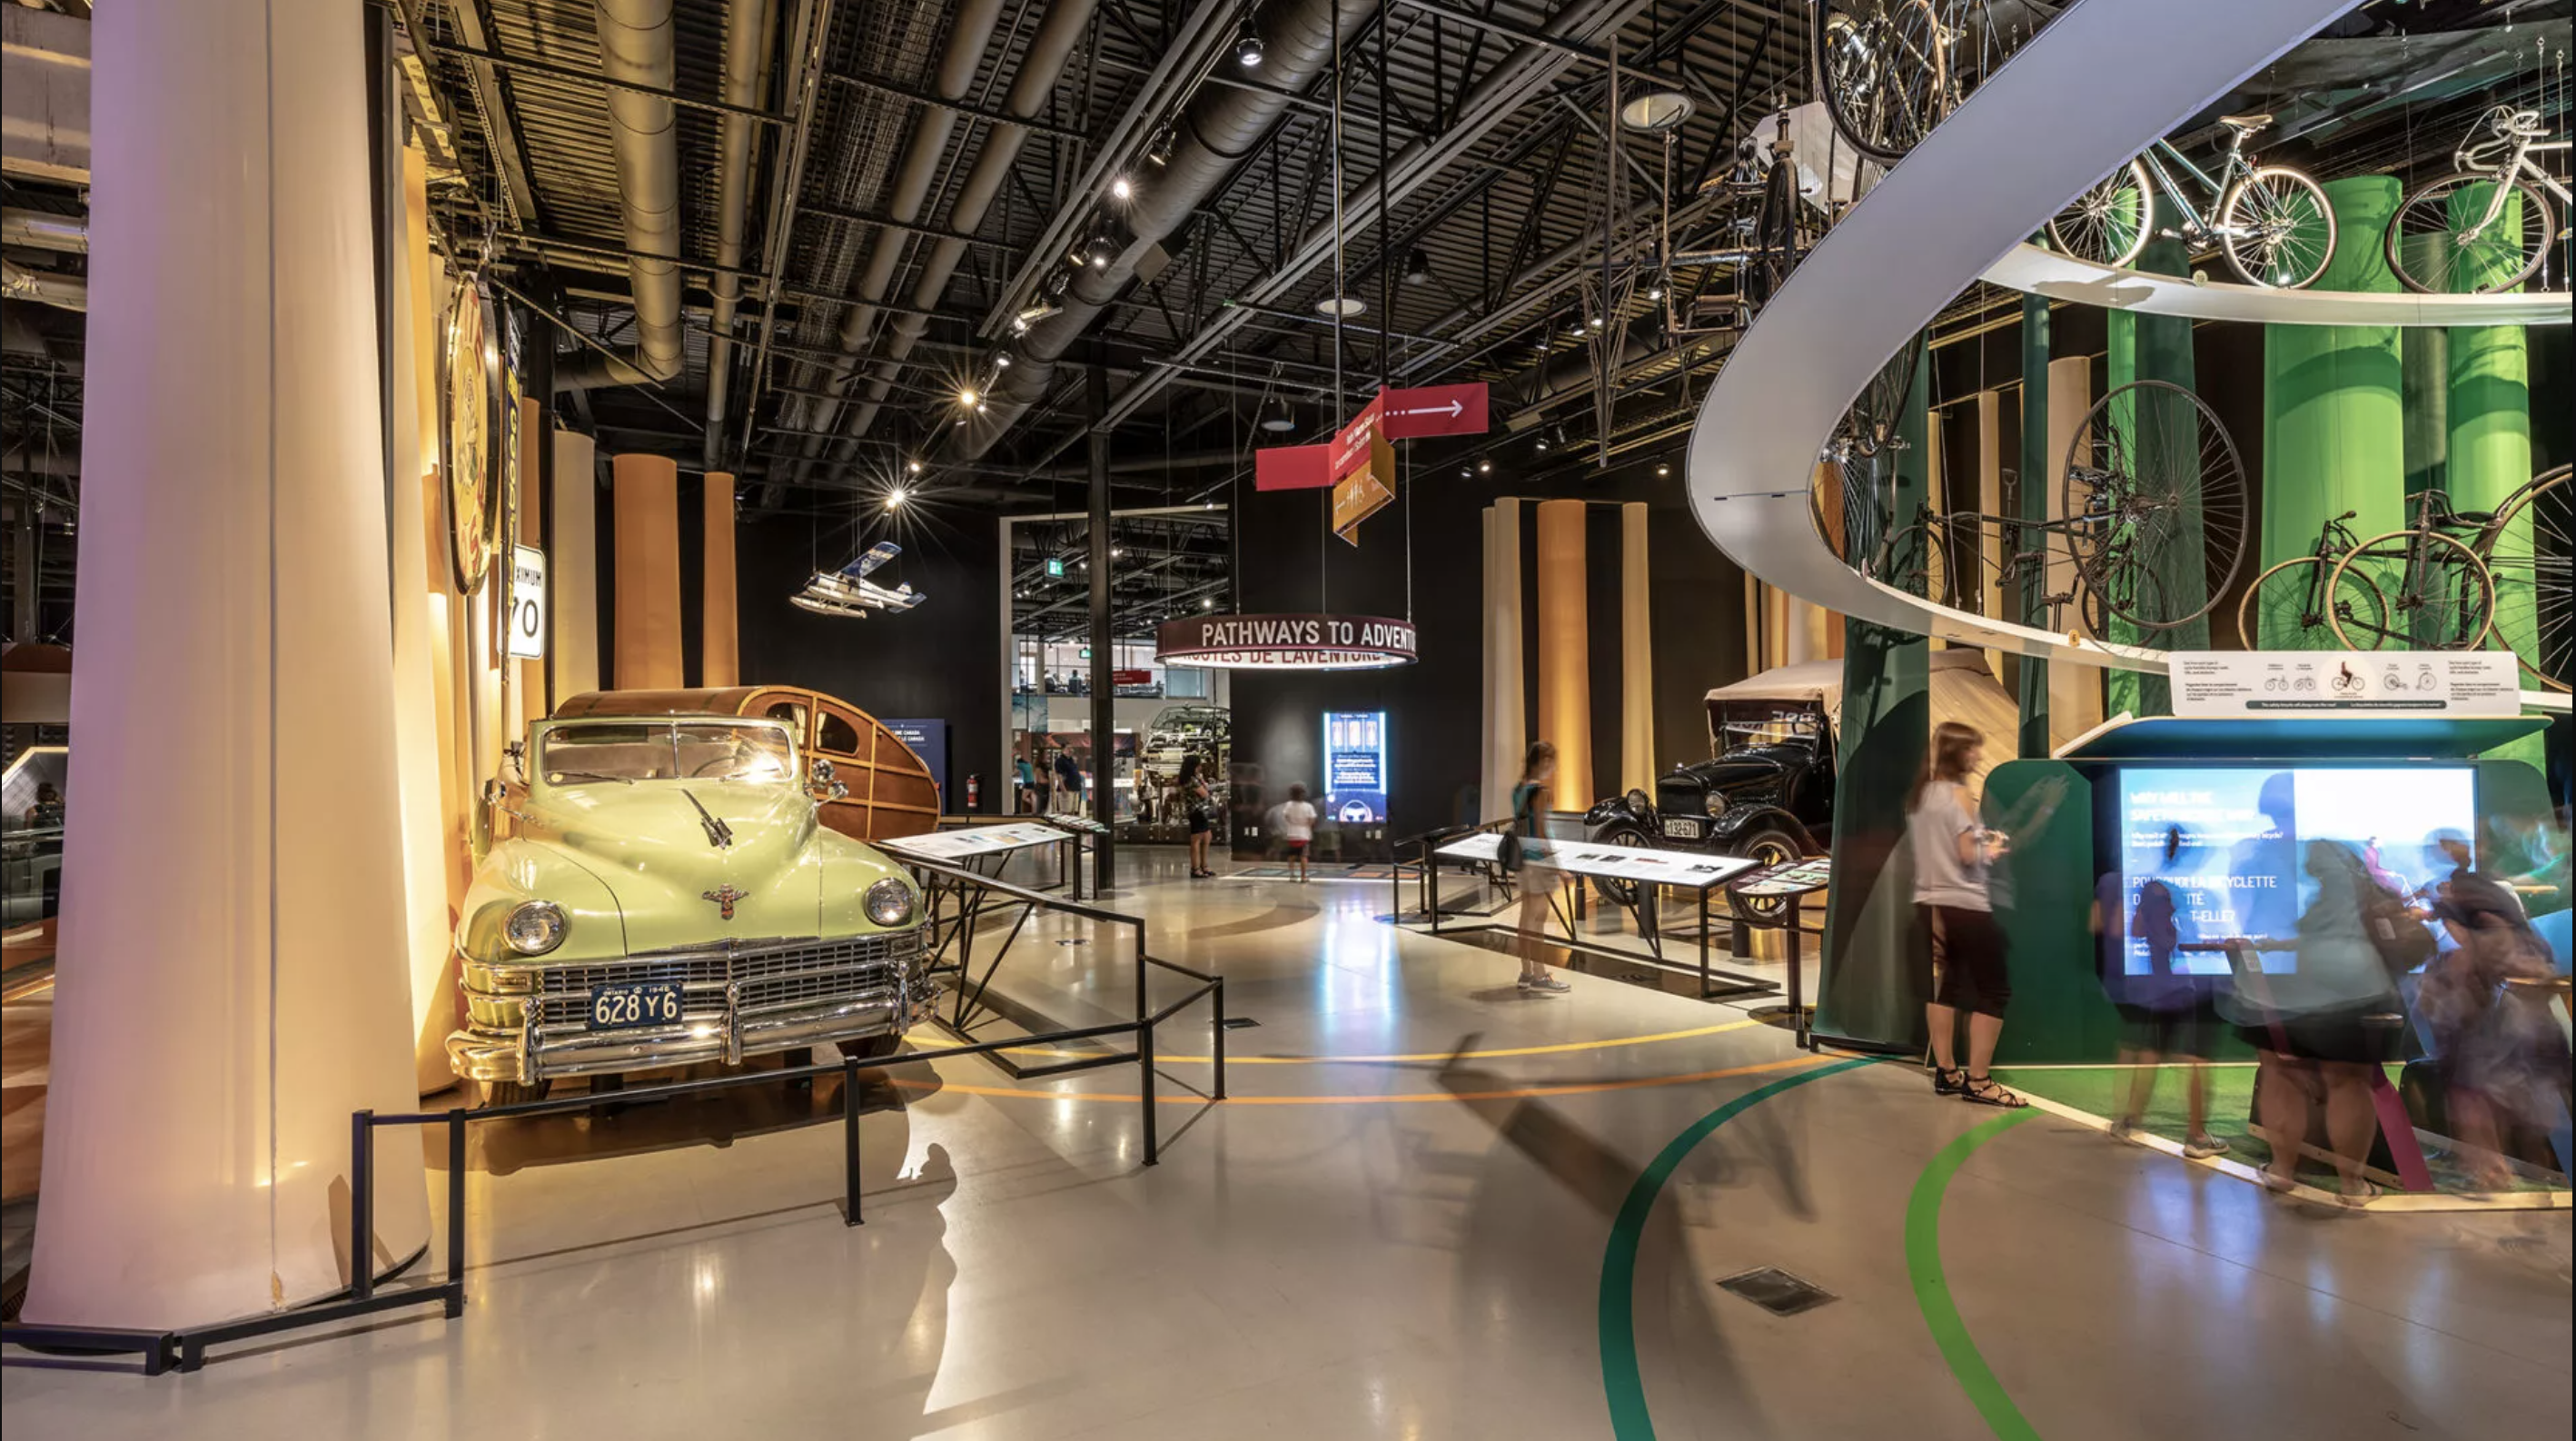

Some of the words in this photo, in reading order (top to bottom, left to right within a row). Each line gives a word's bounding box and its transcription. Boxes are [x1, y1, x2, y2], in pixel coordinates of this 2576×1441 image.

[515, 565, 542, 587] XIMUM
[1202, 620, 1320, 648] PATHWAYS
[1327, 621, 1353, 645] TO
